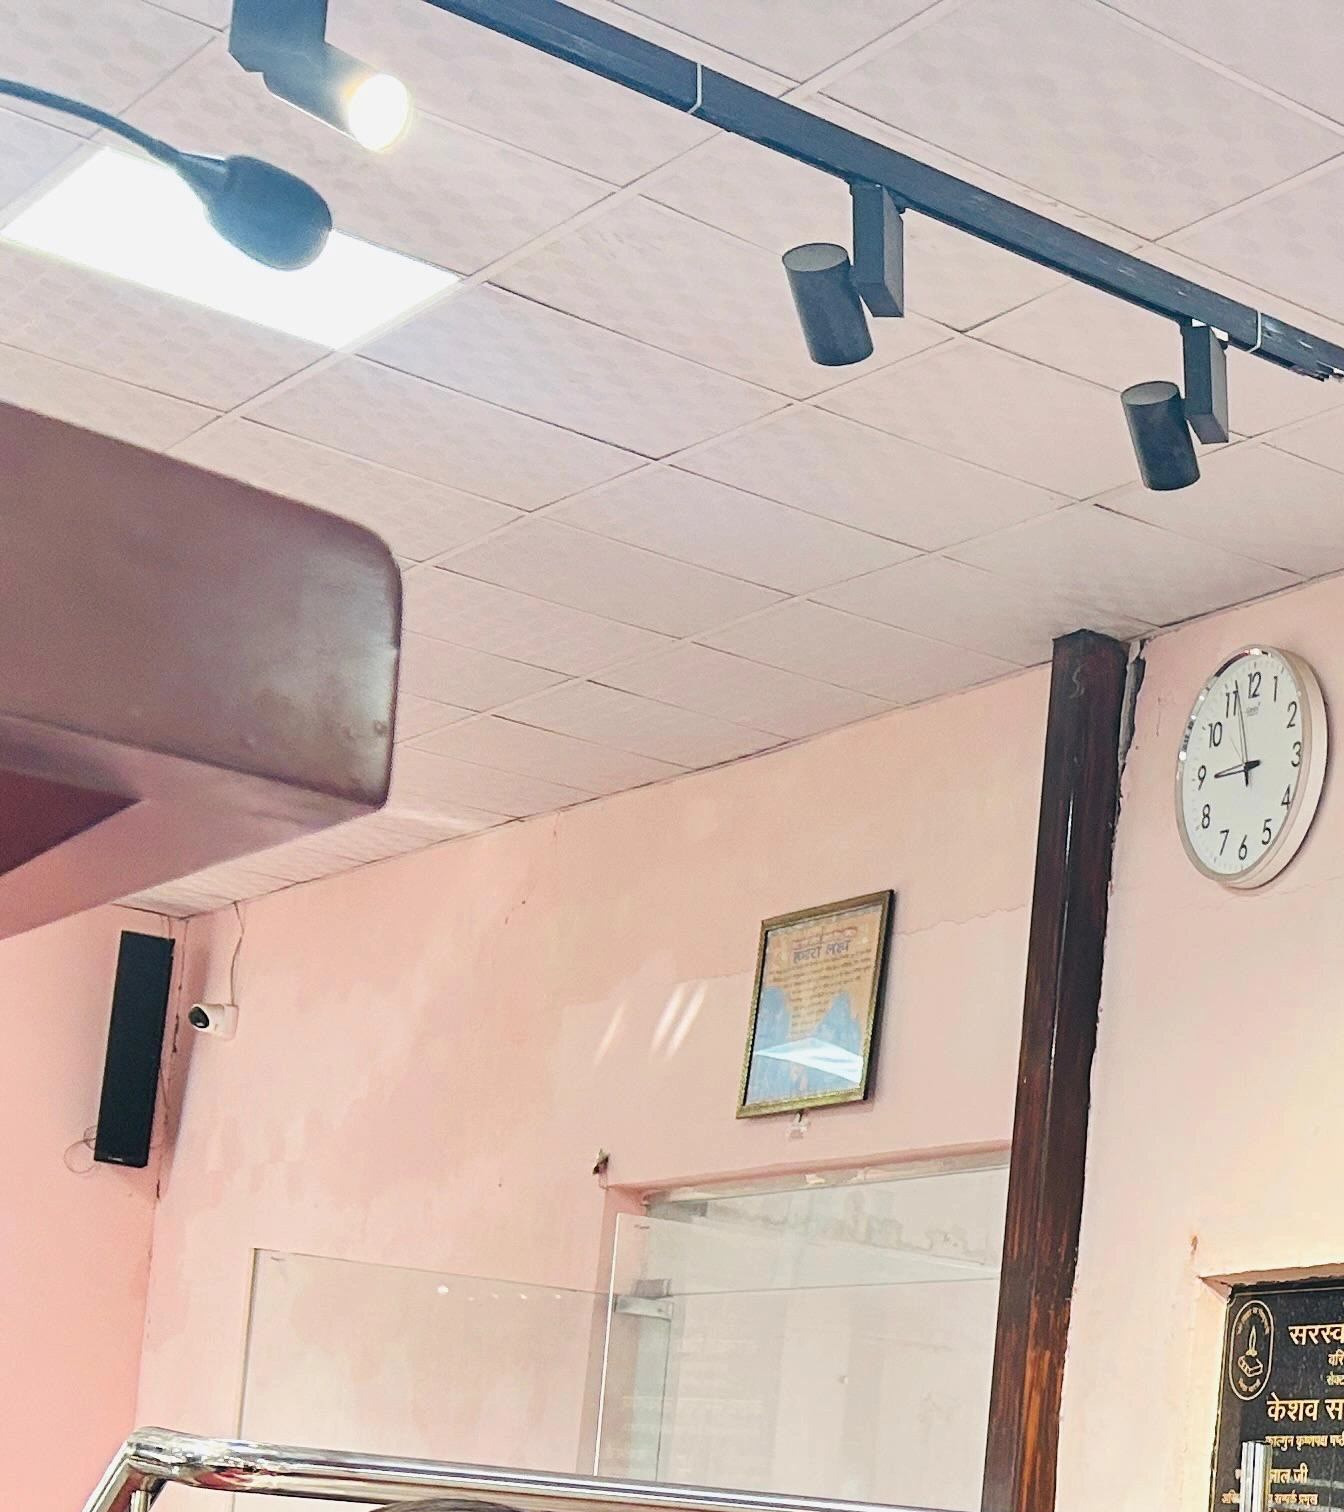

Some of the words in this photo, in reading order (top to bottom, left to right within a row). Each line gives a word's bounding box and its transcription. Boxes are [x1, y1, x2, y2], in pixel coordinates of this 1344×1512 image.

[1248, 671, 1261, 699] 12
[1273, 676, 1278, 702] 1
[1225, 690, 1239, 718] 11
[1286, 701, 1297, 728] 2
[1208, 721, 1222, 748] 10
[1291, 741, 1301, 768] 3
[1197, 765, 1207, 791] 9
[1281, 784, 1291, 810] 4
[1201, 804, 1211, 829] 8
[1219, 829, 1229, 856] 7
[1261, 819, 1272, 845] 5
[1238, 834, 1247, 861] 6
[1266, 1391, 1320, 1422] केशव
